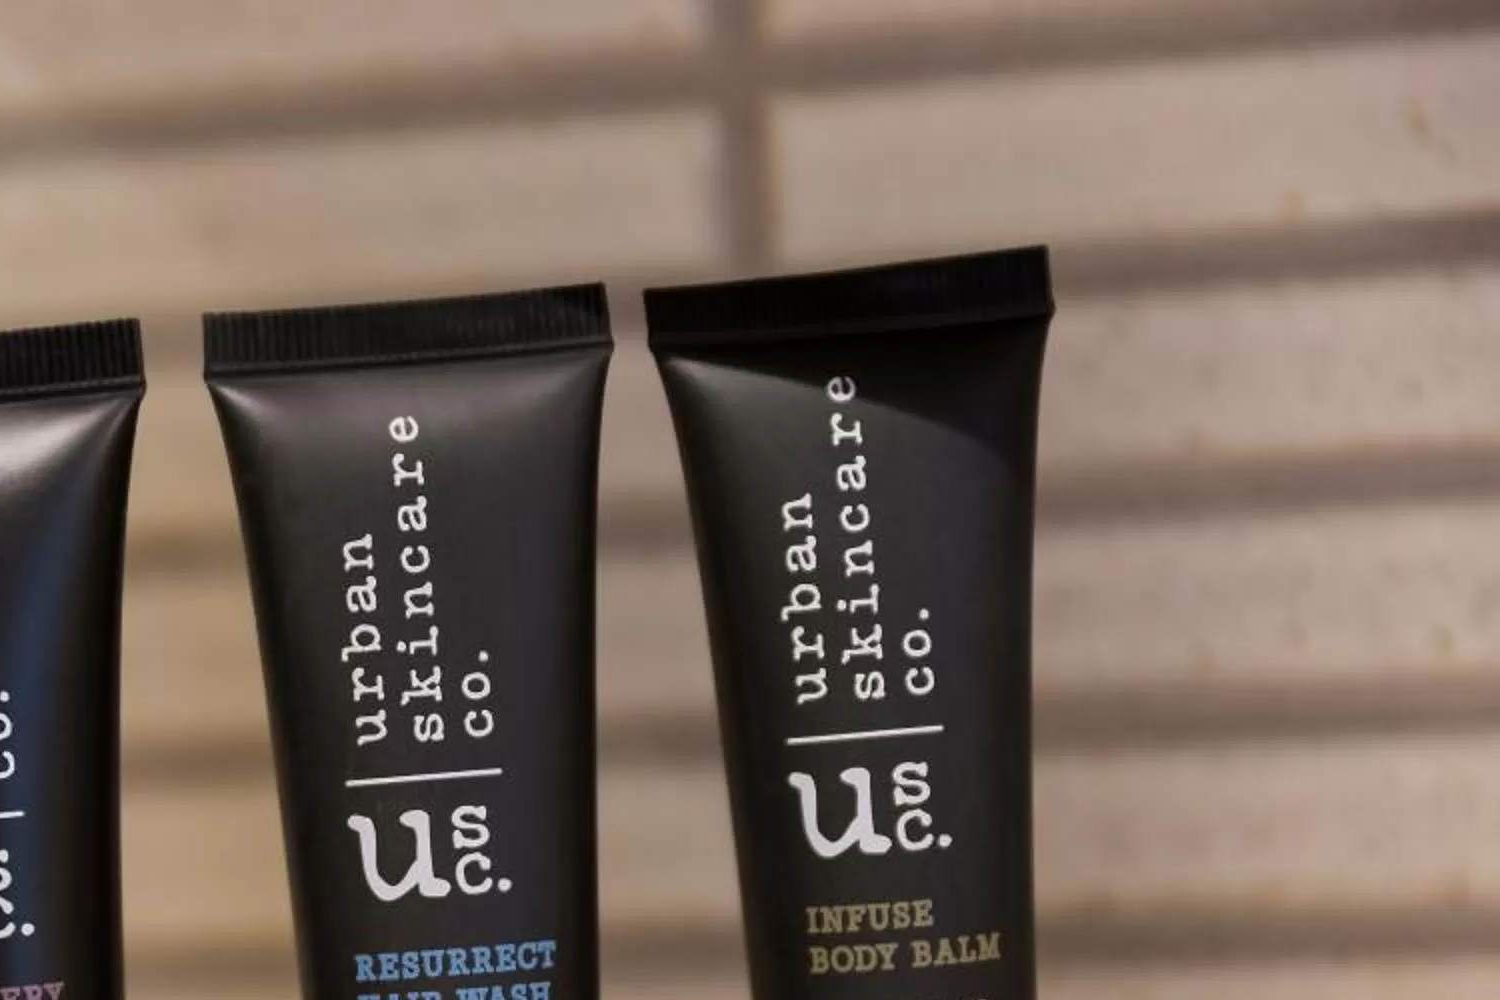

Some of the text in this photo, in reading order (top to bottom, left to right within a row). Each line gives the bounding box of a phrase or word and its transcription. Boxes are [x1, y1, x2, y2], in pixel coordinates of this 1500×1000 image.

[389, 415, 445, 743] skincare
[826, 376, 886, 701] skincare
[340, 533, 388, 746] urban
[781, 492, 829, 705] urban
[461, 650, 494, 739] co.
[903, 608, 935, 695] co.
[354, 940, 556, 981] RESURRECT
[806, 899, 934, 934] INFUSE
[810, 932, 1002, 975] BODY BALM
